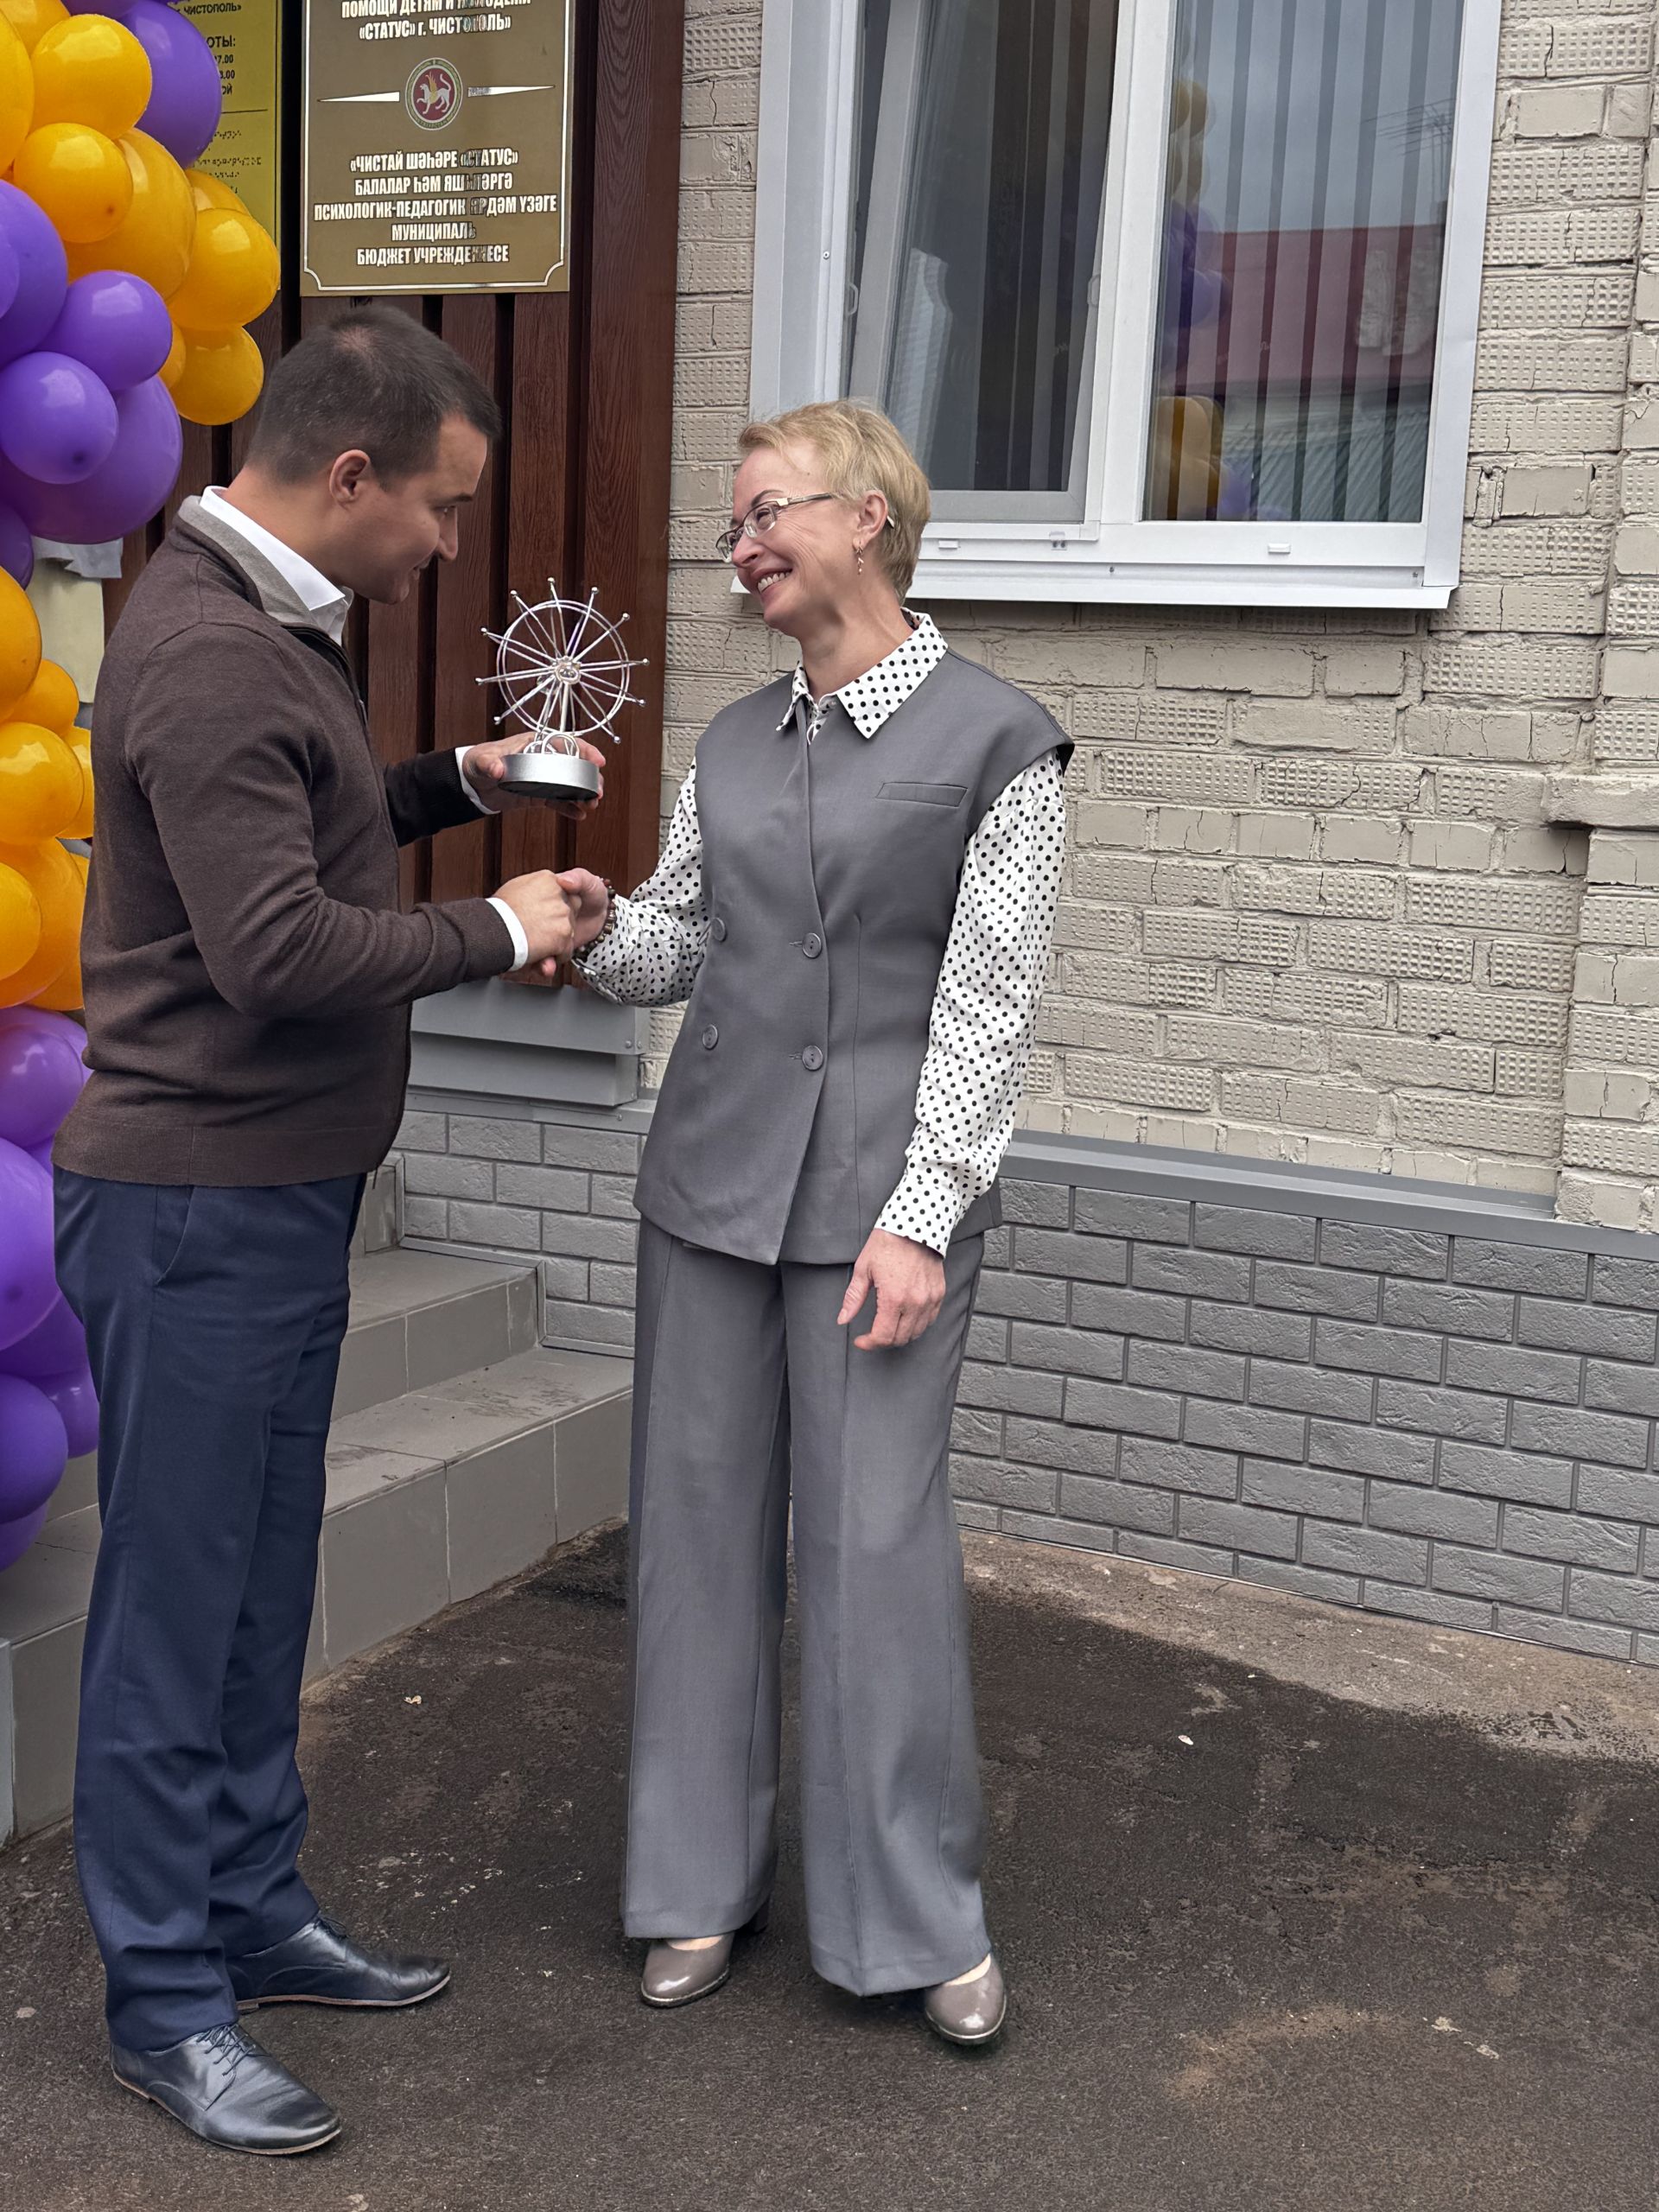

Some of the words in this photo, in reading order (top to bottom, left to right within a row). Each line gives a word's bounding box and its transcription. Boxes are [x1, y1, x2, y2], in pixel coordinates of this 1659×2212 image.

[184, 3, 242, 15] ЧИСТОПОЛЬ»
[341, 0, 397, 18] ПОМОЩИ
[359, 20, 416, 40] «СТАТУС»
[429, 13, 512, 35] ЧИСТОПОЛЬ»
[206, 35, 236, 48] ОТЫ:
[214, 54, 234, 64] 7.00
[350, 150, 404, 173] «ЧИСТАЙ
[460, 148, 518, 168] «СТАТУС»
[355, 176, 411, 196] БАЛАЛАР
[314, 200, 466, 221] ПСИХОЛОГИК-ПЕДАГОГИК
[391, 221, 476, 243] МУНИЦИПАЛЬ
[357, 247, 411, 267] БЮДЖЕТ
